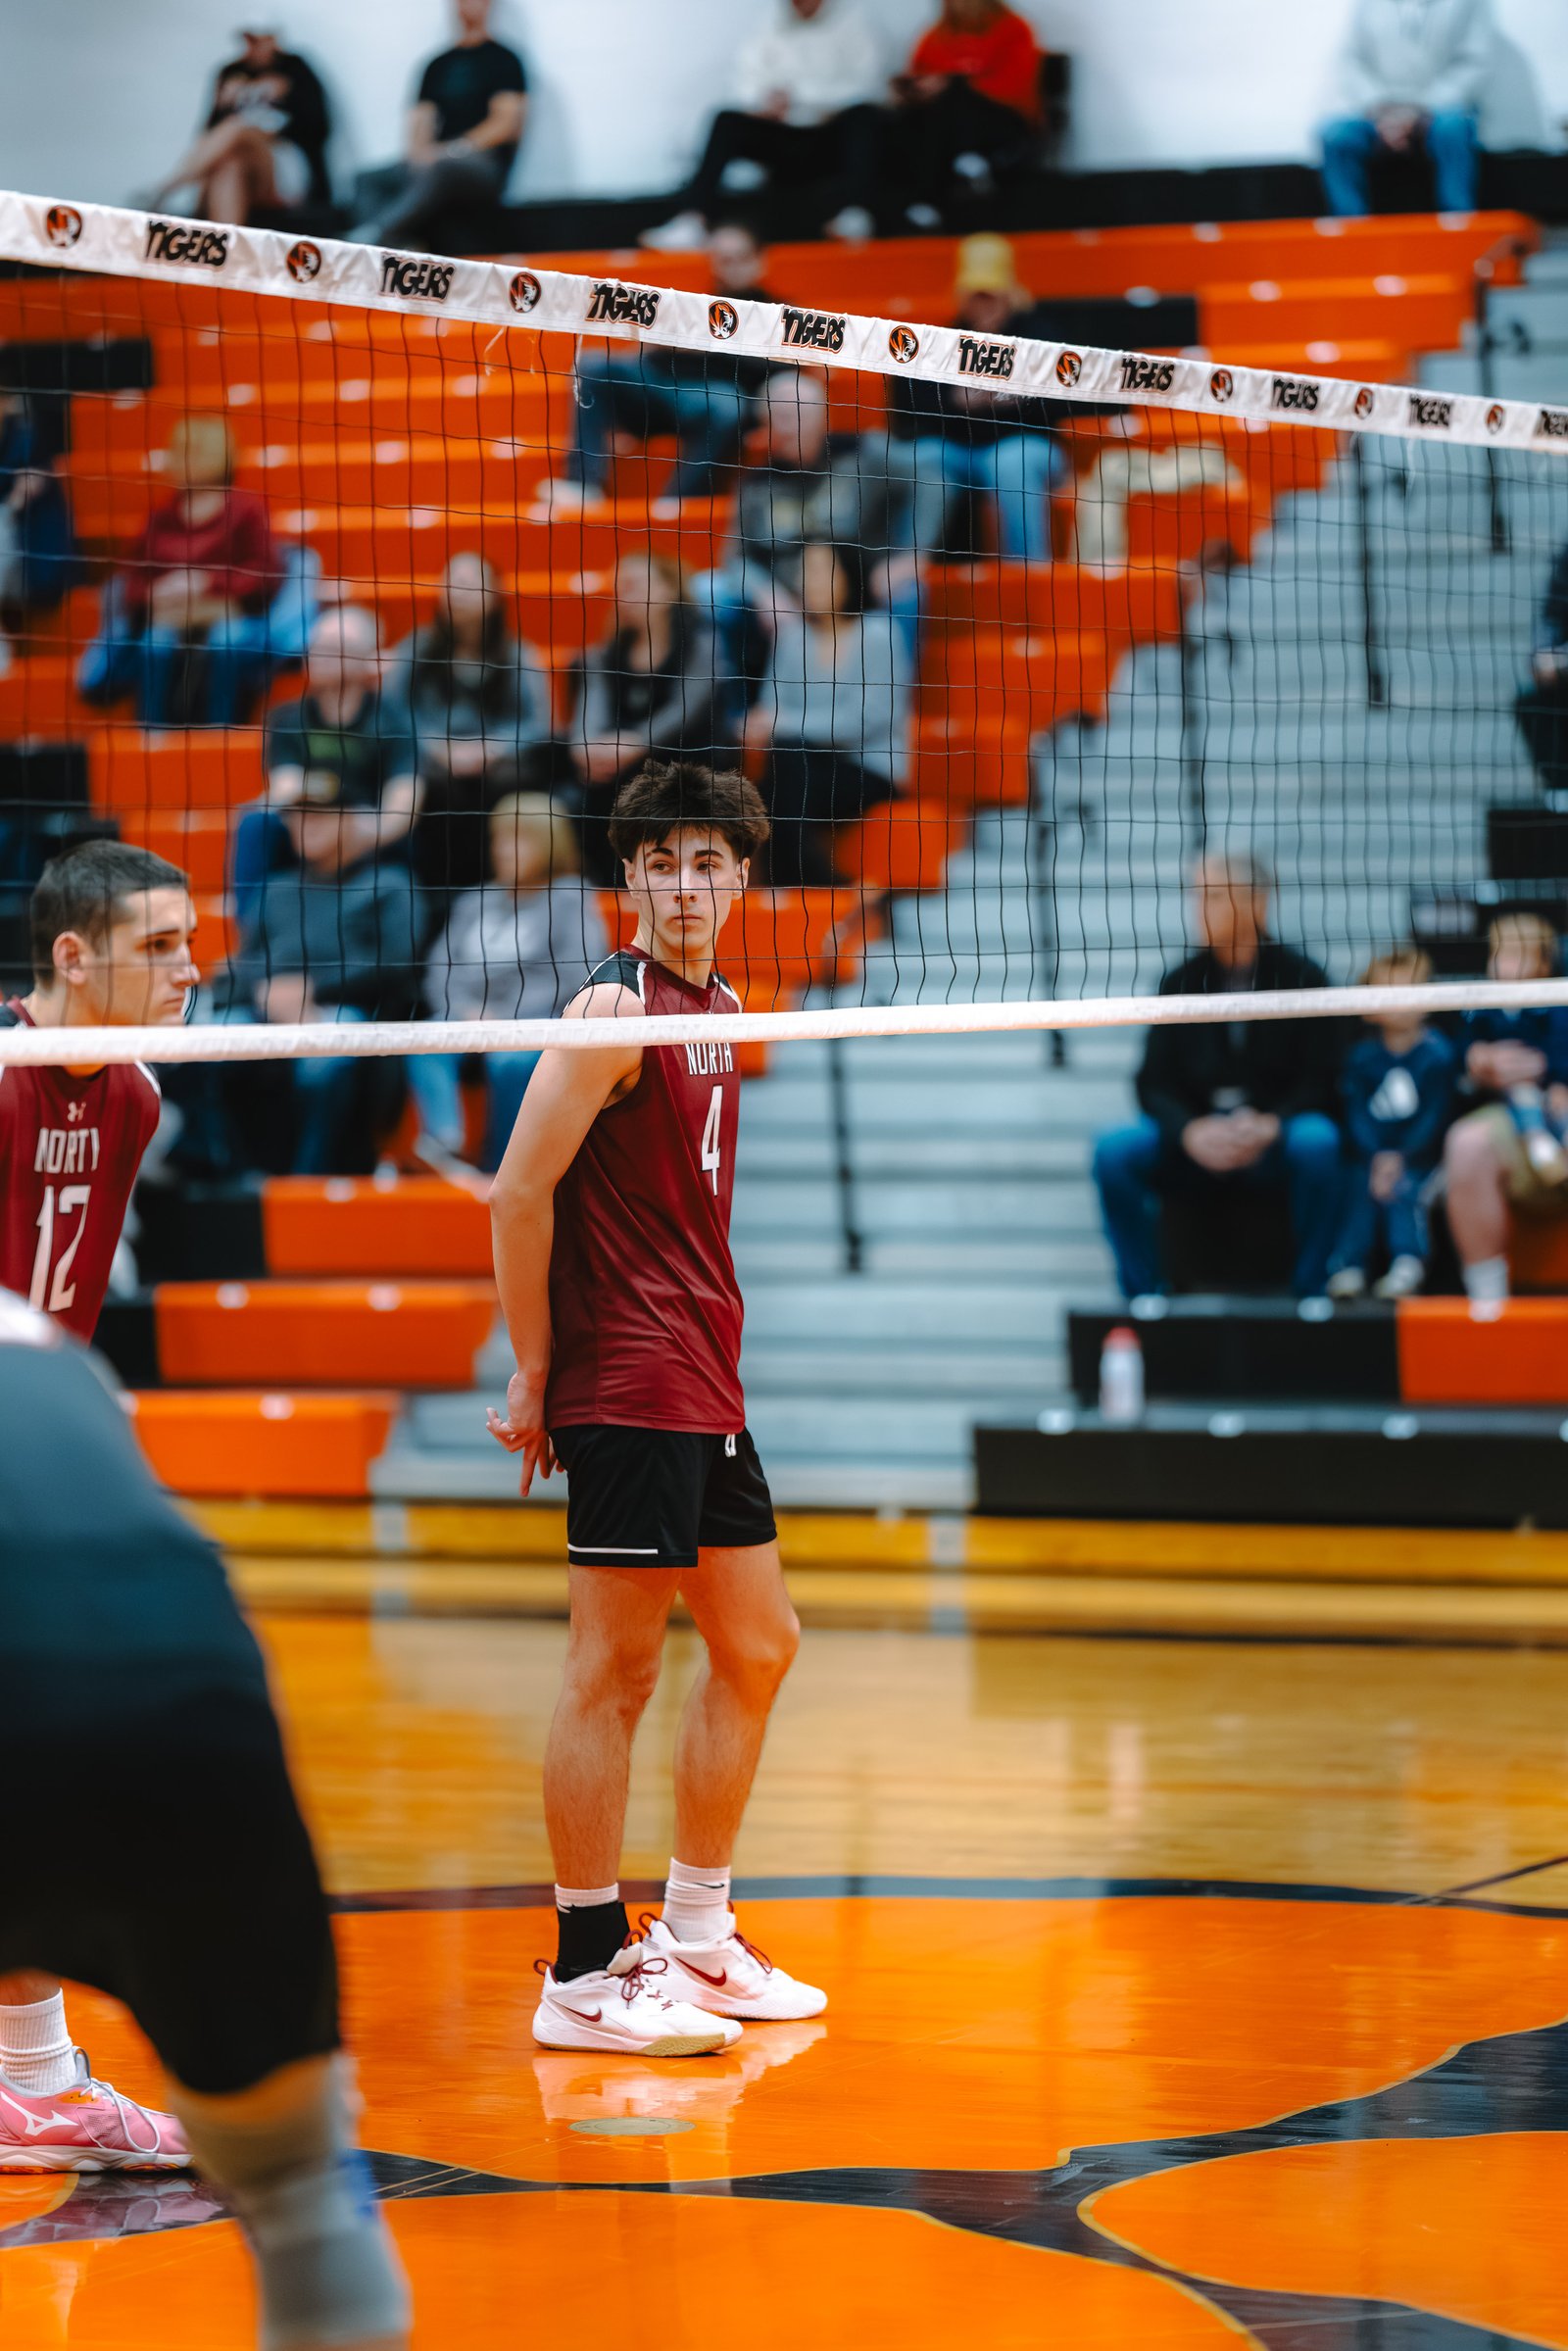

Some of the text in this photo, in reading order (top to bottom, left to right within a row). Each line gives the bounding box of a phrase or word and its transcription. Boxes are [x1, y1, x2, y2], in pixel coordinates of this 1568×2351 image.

[146, 220, 228, 267] TIGERS
[382, 255, 456, 300] TIGERS
[585, 281, 661, 328] TIGERS
[783, 305, 849, 354] TIGERS
[958, 335, 1016, 380] TIGERS
[1120, 357, 1175, 392] TIGERS
[1408, 396, 1451, 427] TIGER
[683, 1043, 734, 1075] NORTH
[701, 1085, 722, 1196] 4
[28, 1184, 92, 1312] 12
